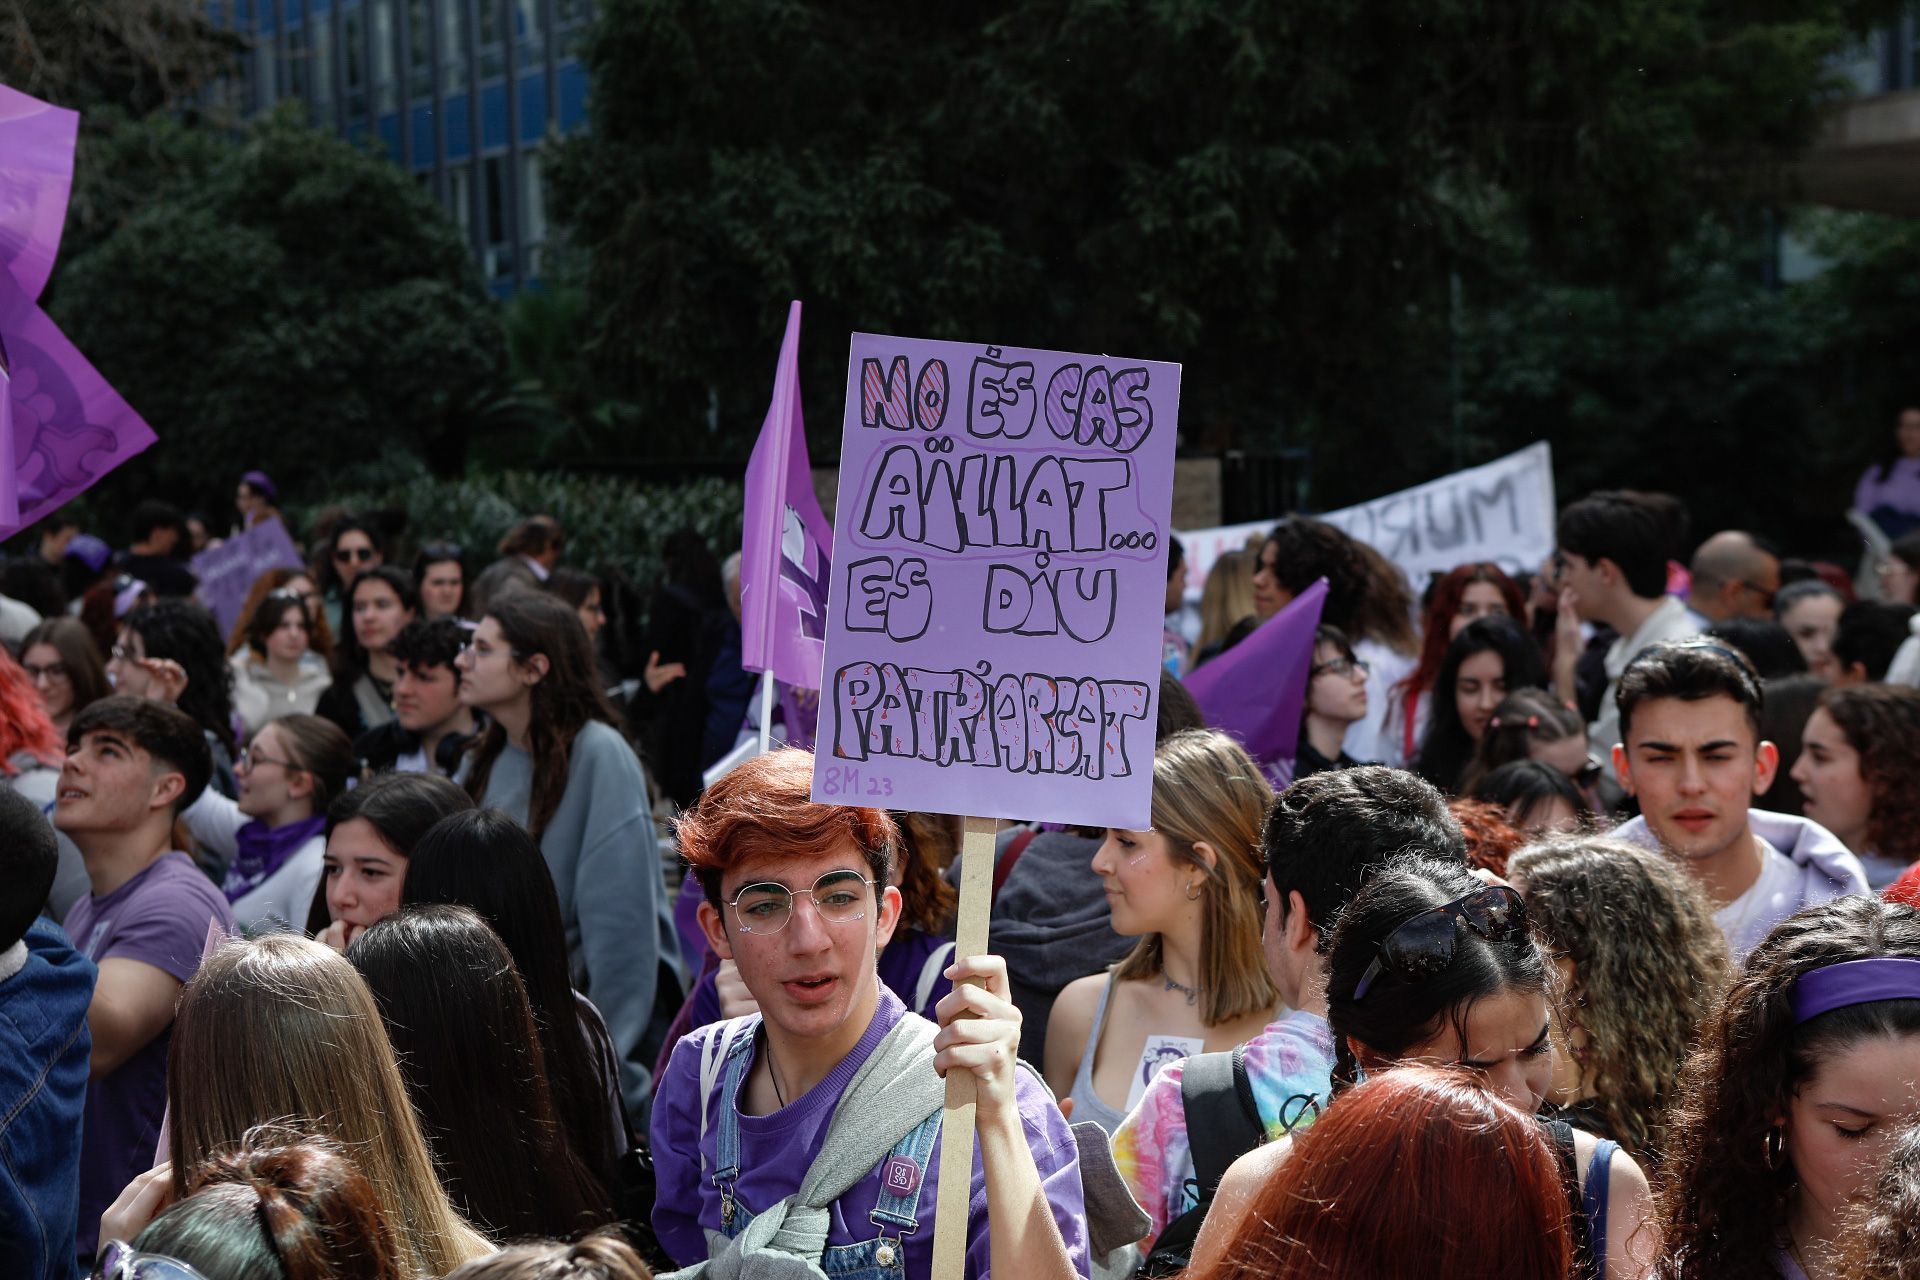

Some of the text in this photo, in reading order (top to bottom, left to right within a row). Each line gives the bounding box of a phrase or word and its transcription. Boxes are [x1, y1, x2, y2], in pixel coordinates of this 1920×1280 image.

[861, 355, 950, 431] NO
[1044, 362, 1154, 454] CAS
[844, 556, 932, 643] ES
[823, 765, 893, 796] 8M 23
